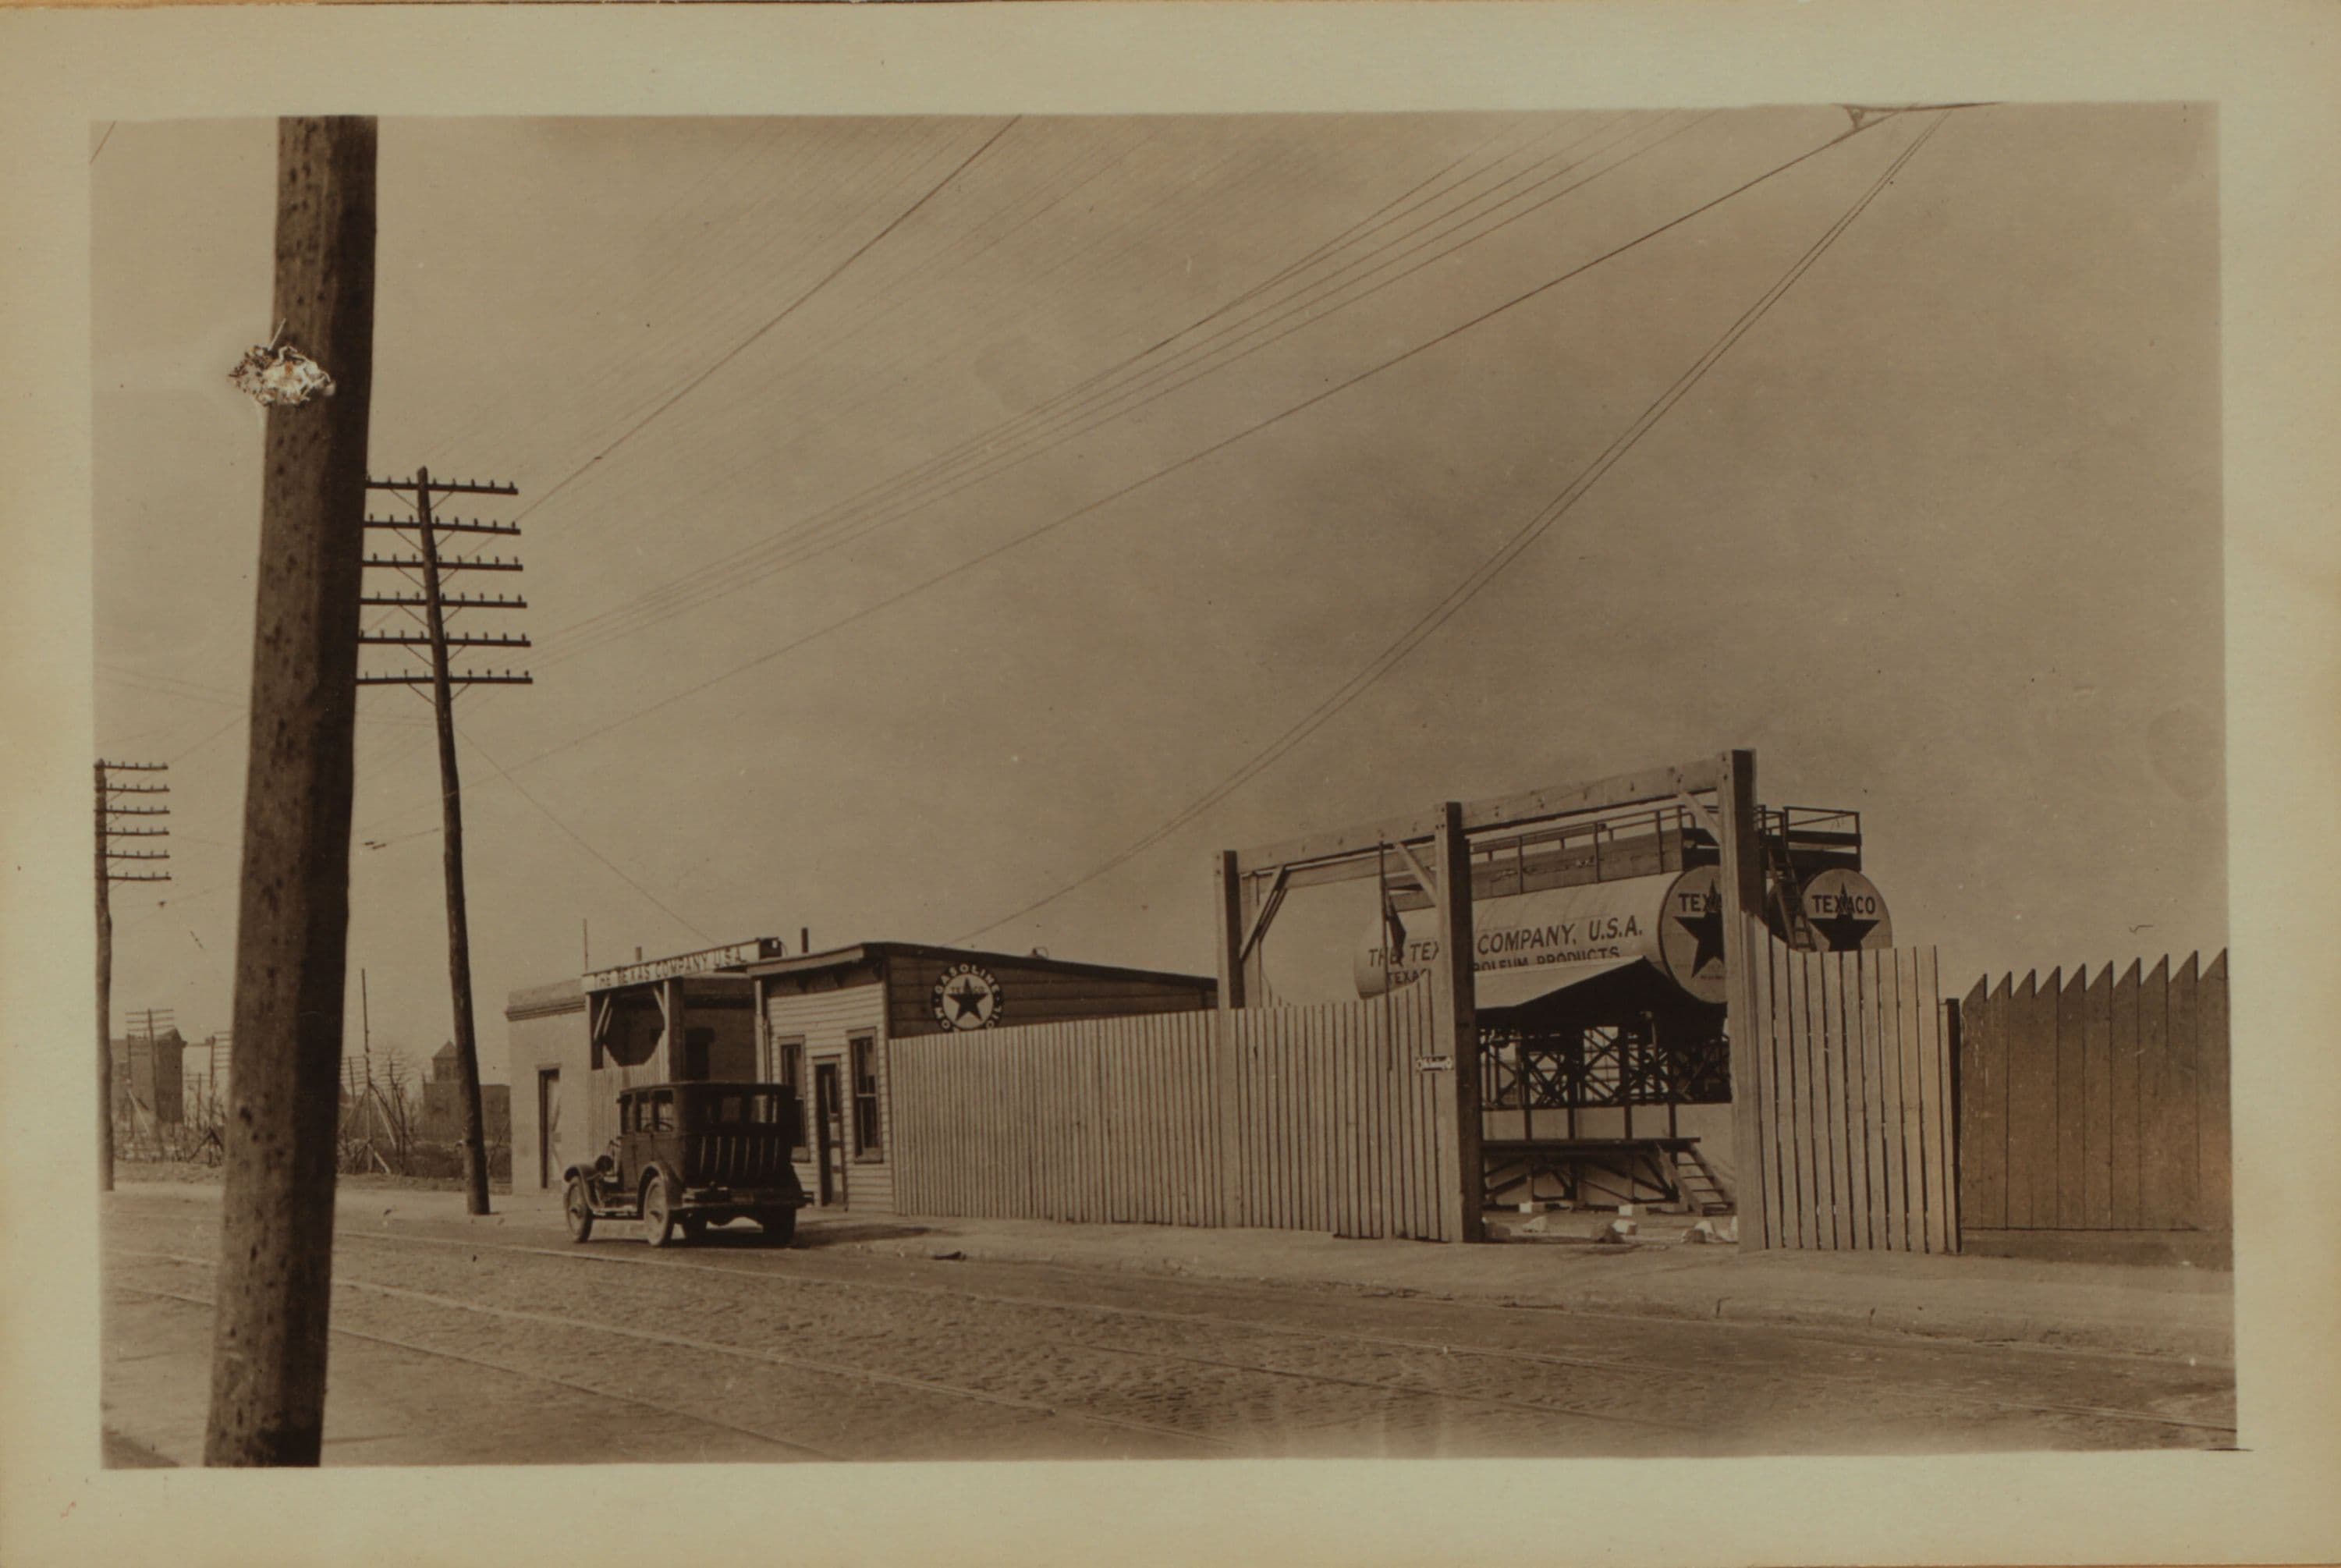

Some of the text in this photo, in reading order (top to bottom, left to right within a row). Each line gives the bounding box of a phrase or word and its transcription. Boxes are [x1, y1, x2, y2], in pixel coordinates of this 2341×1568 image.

[1410, 940, 1439, 963] TEX
[1477, 923, 1577, 956] COMPANY,
[1589, 914, 1642, 942] U.S.A.
[593, 970, 612, 988] THE
[654, 952, 708, 977] COMPANY
[935, 963, 1000, 995] GASOLINE
